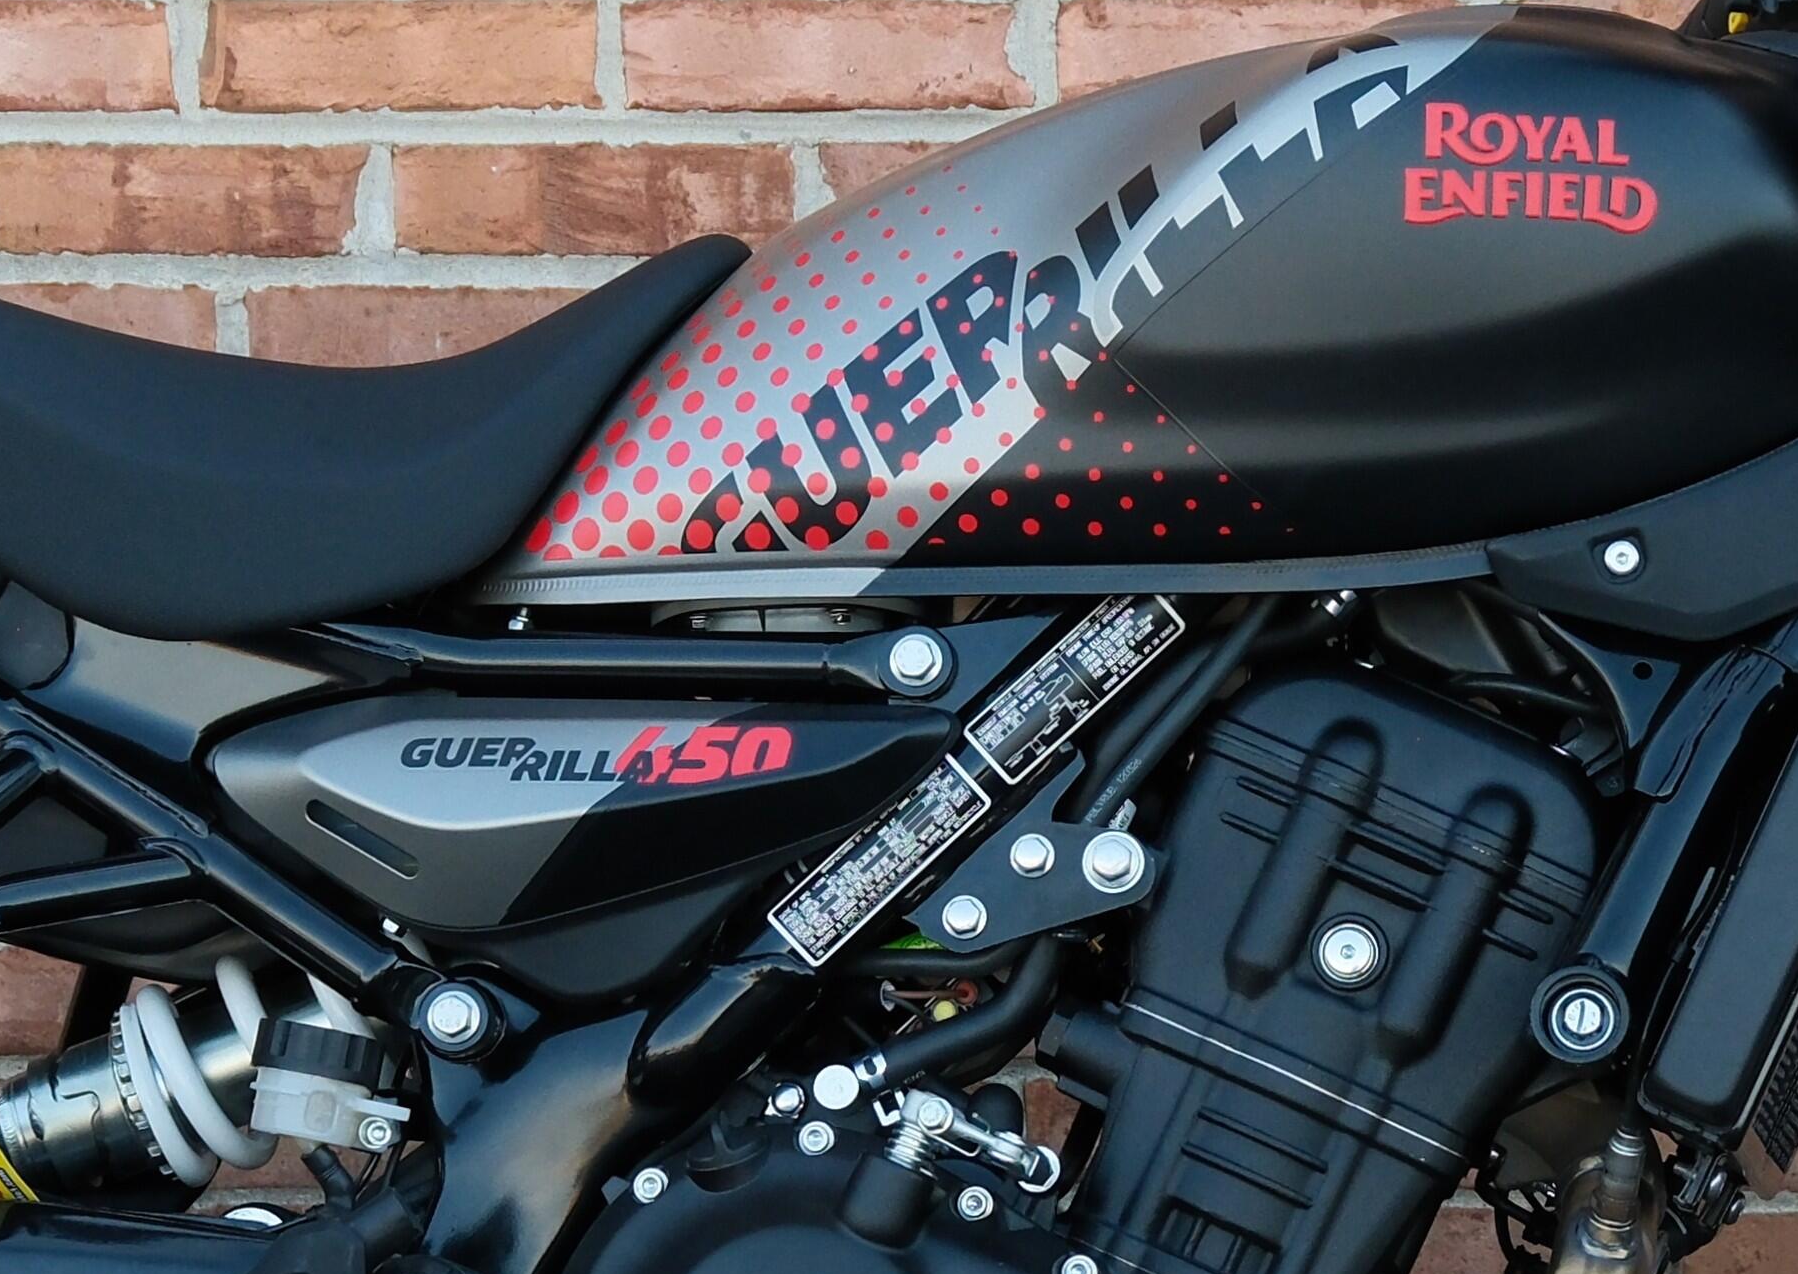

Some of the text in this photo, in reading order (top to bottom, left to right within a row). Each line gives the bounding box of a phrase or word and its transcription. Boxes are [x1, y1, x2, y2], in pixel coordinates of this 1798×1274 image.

[1425, 102, 1631, 166] ROYAL
[1404, 167, 1659, 235] ENFIELD
[400, 725, 793, 785] GUERRILLA 450
